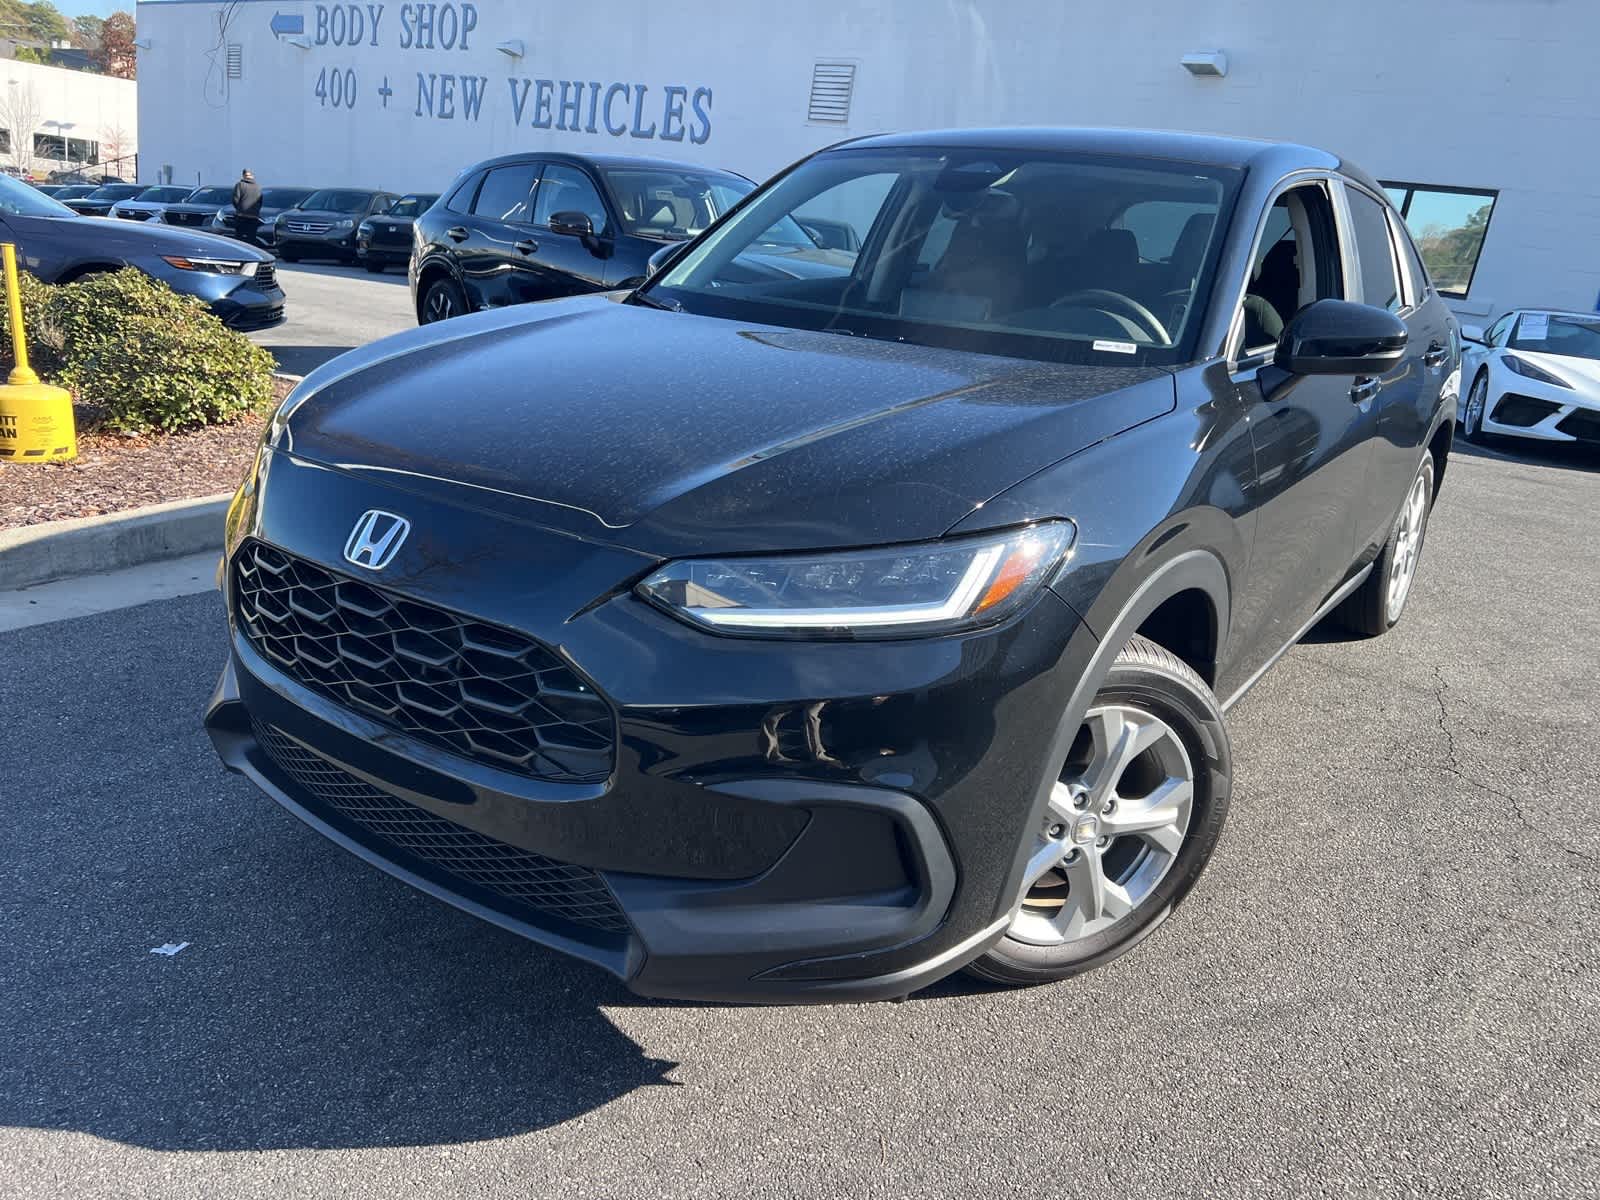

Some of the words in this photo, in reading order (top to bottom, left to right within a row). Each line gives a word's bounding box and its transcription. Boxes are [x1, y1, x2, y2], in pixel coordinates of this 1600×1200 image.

[315, 4, 385, 47] BODY
[400, 2, 478, 50] SHOP
[315, 66, 357, 109] 400
[415, 72, 488, 122] NEW
[508, 77, 712, 145] VEHICLES
[0, 415, 17, 426] TT
